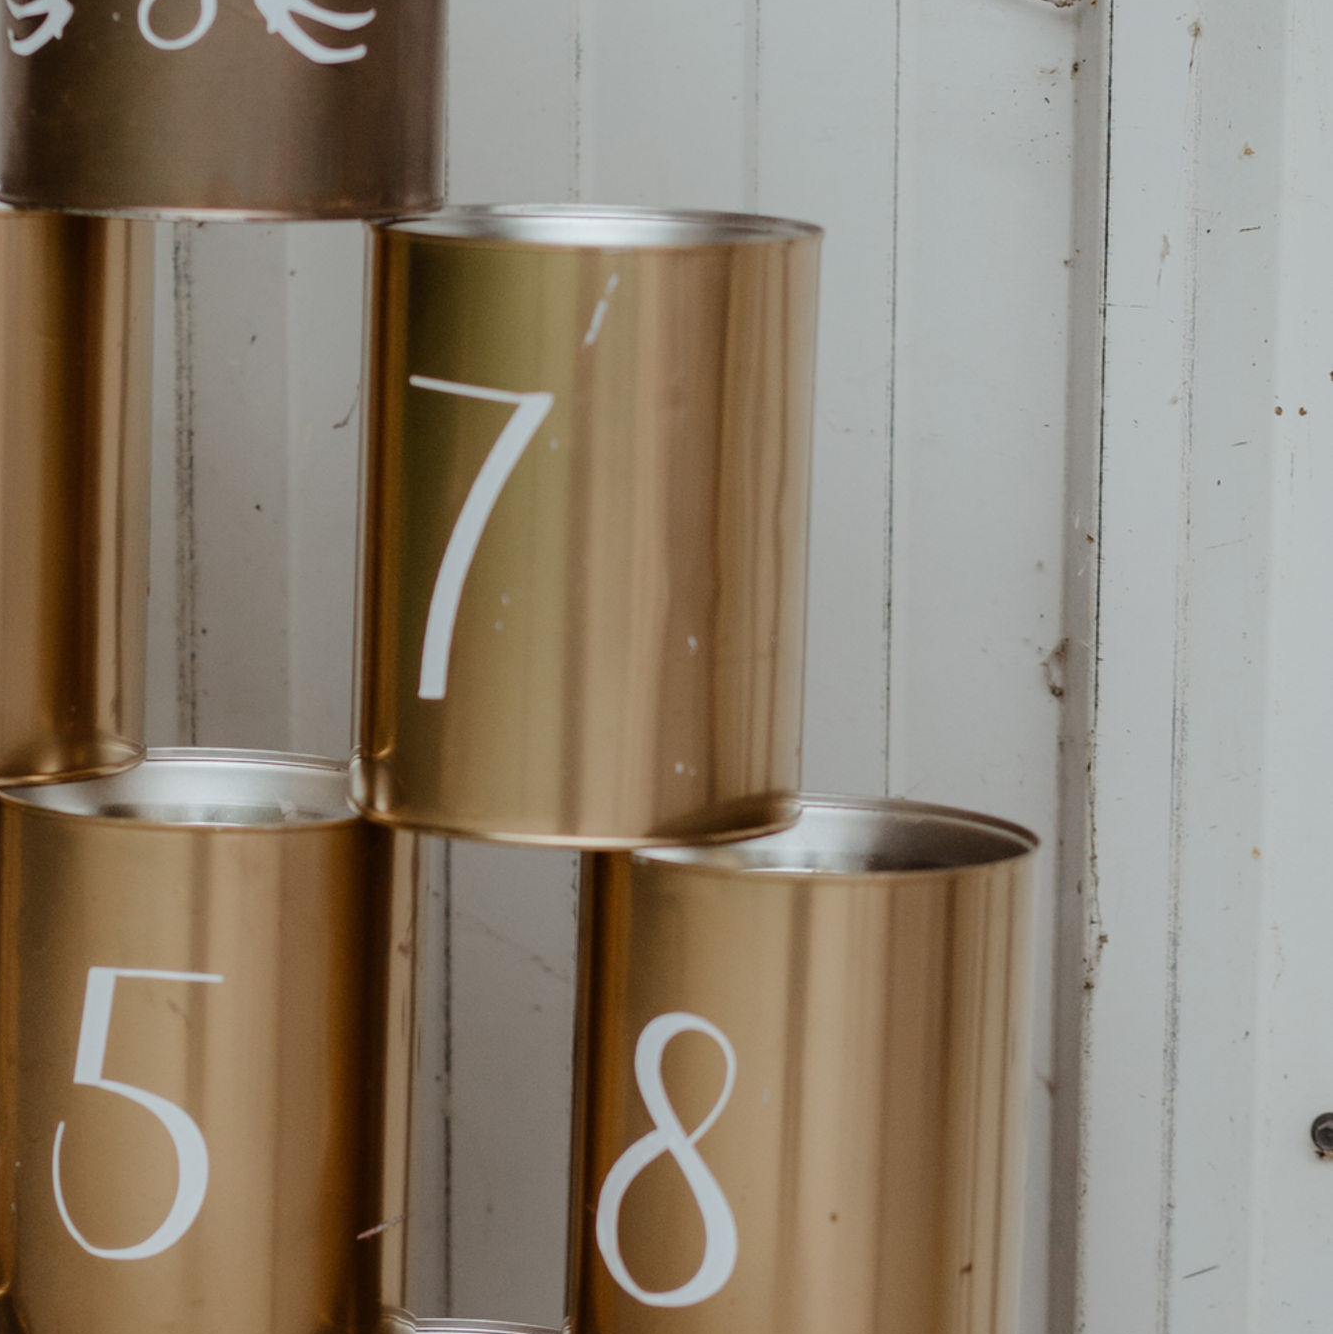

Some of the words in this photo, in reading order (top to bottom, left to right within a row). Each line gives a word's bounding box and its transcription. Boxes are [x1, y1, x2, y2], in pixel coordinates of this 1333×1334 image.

[409, 374, 554, 700] 7
[52, 966, 224, 1260] 5
[596, 1012, 738, 1308] 8
